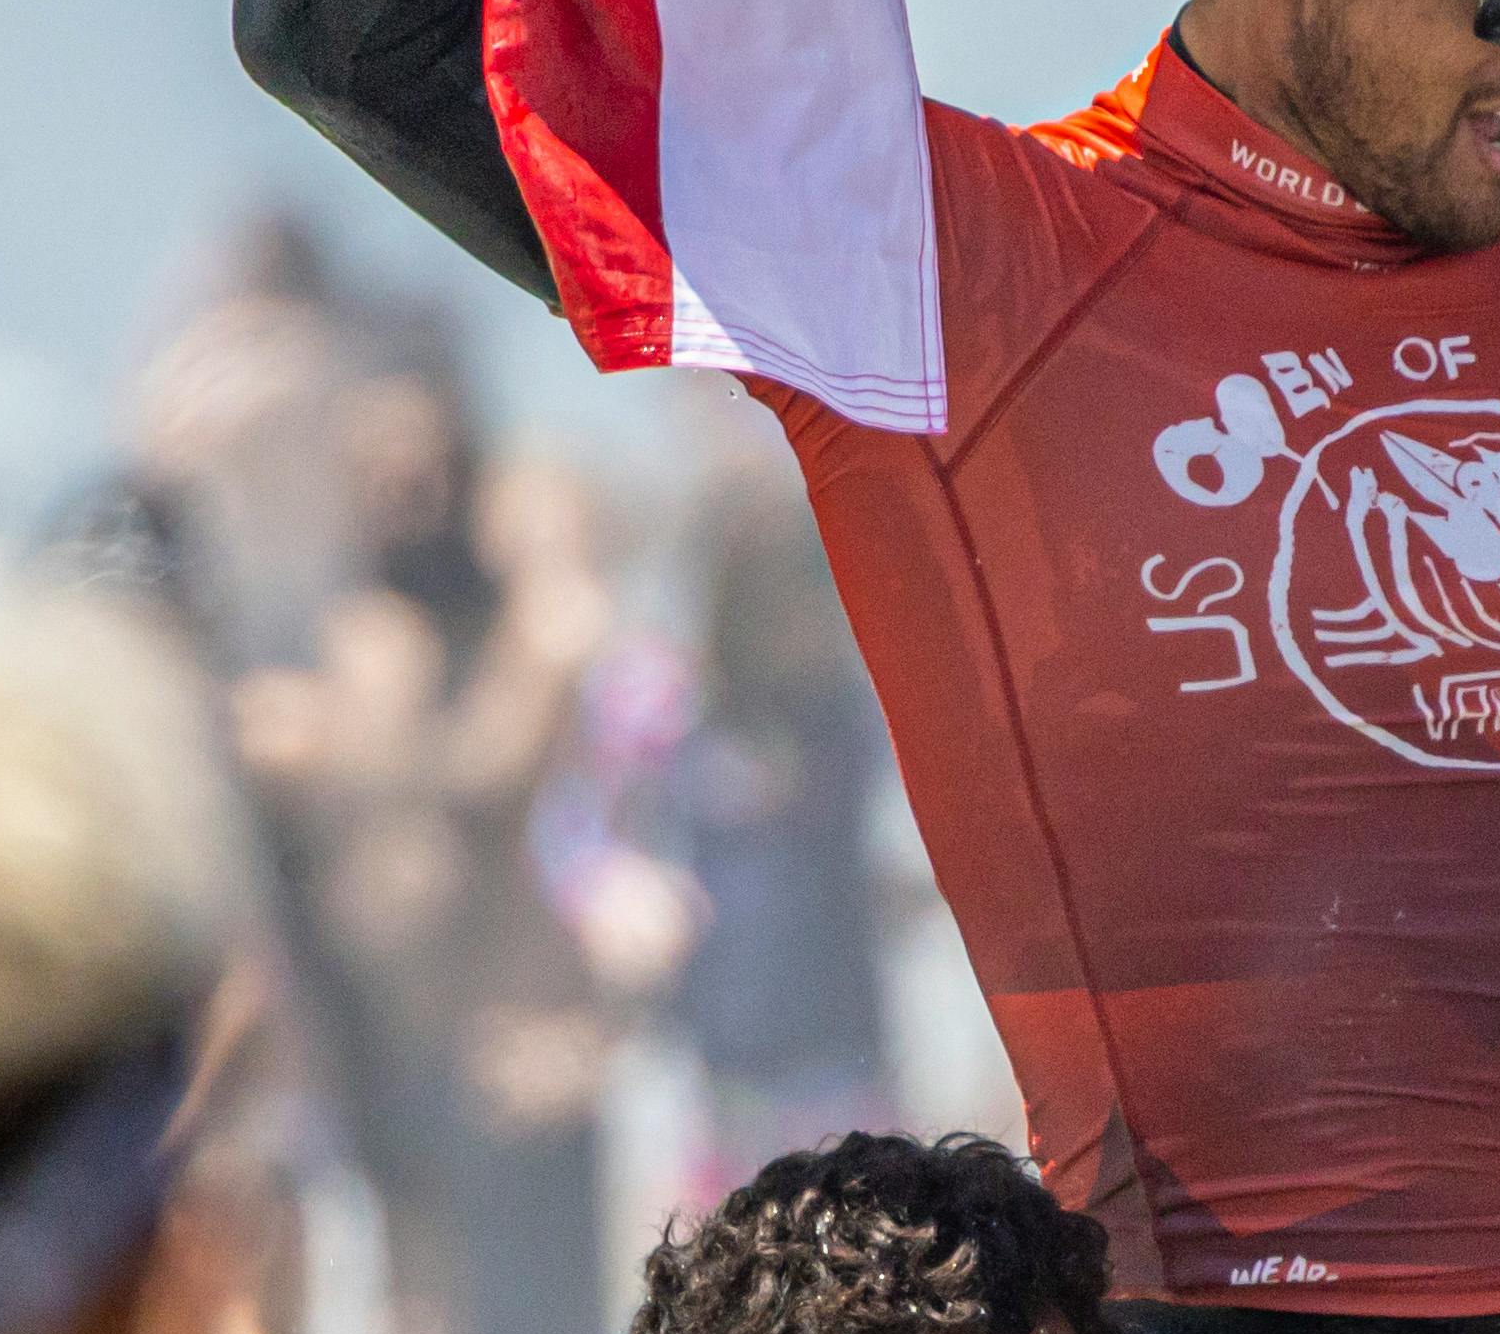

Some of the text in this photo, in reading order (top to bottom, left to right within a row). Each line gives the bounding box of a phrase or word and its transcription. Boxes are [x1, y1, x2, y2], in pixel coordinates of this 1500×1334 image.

[1230, 138, 1346, 207] WORLD
[1140, 553, 1257, 692] US
[1392, 334, 1477, 382] OF
